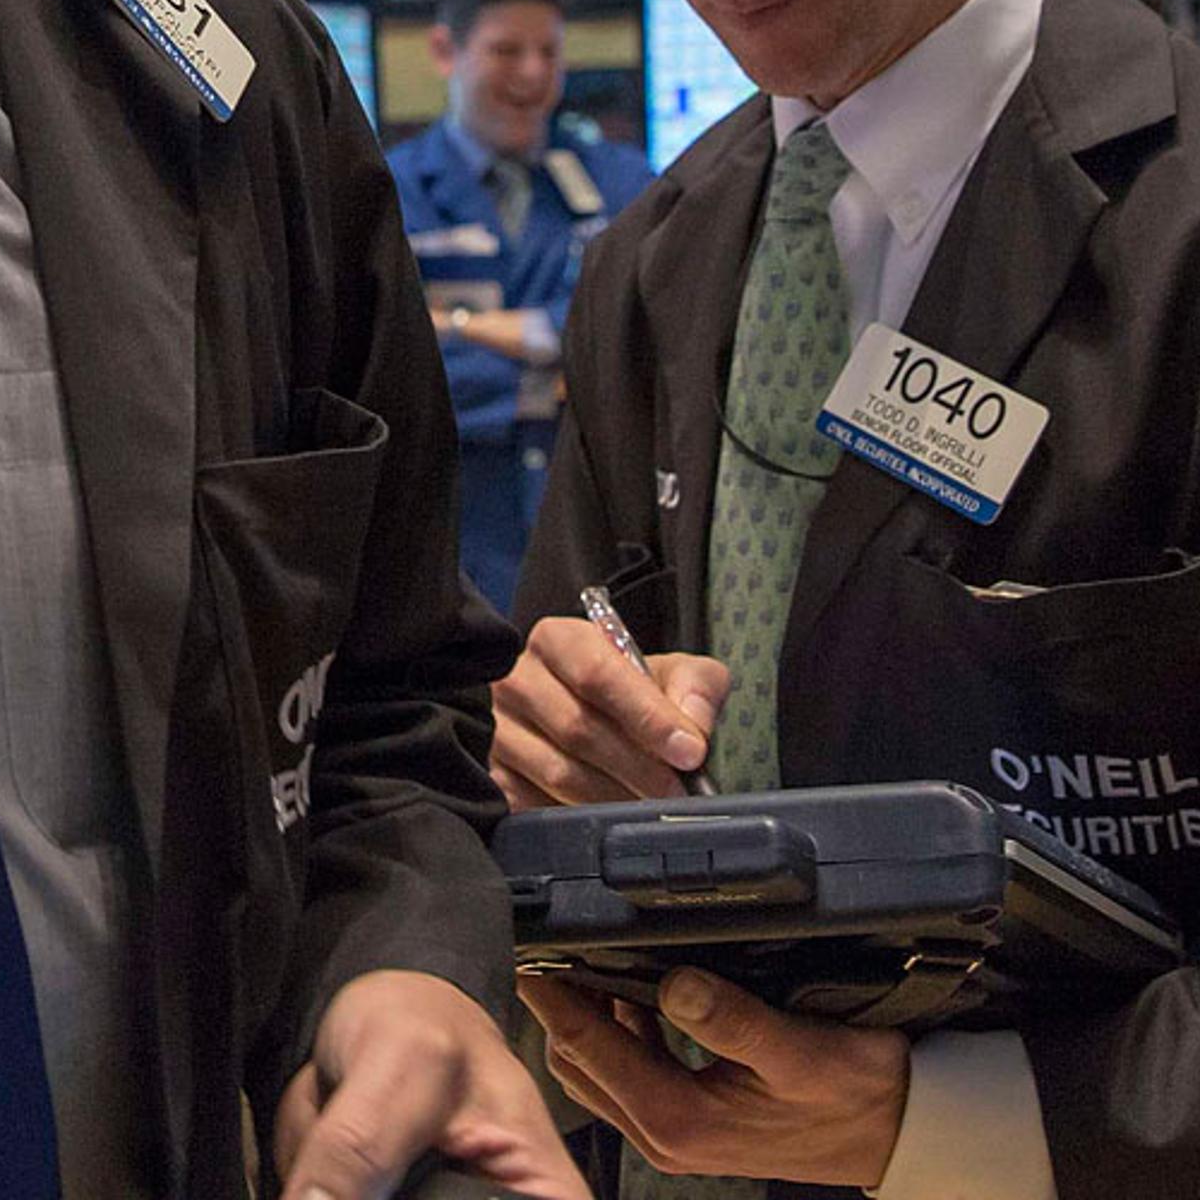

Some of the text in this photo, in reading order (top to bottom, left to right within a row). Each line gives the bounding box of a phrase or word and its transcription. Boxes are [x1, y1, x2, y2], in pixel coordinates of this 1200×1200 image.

[865, 394, 904, 424] TODD
[884, 346, 1007, 440] 1040
[990, 748, 1199, 798] O'NEIL
